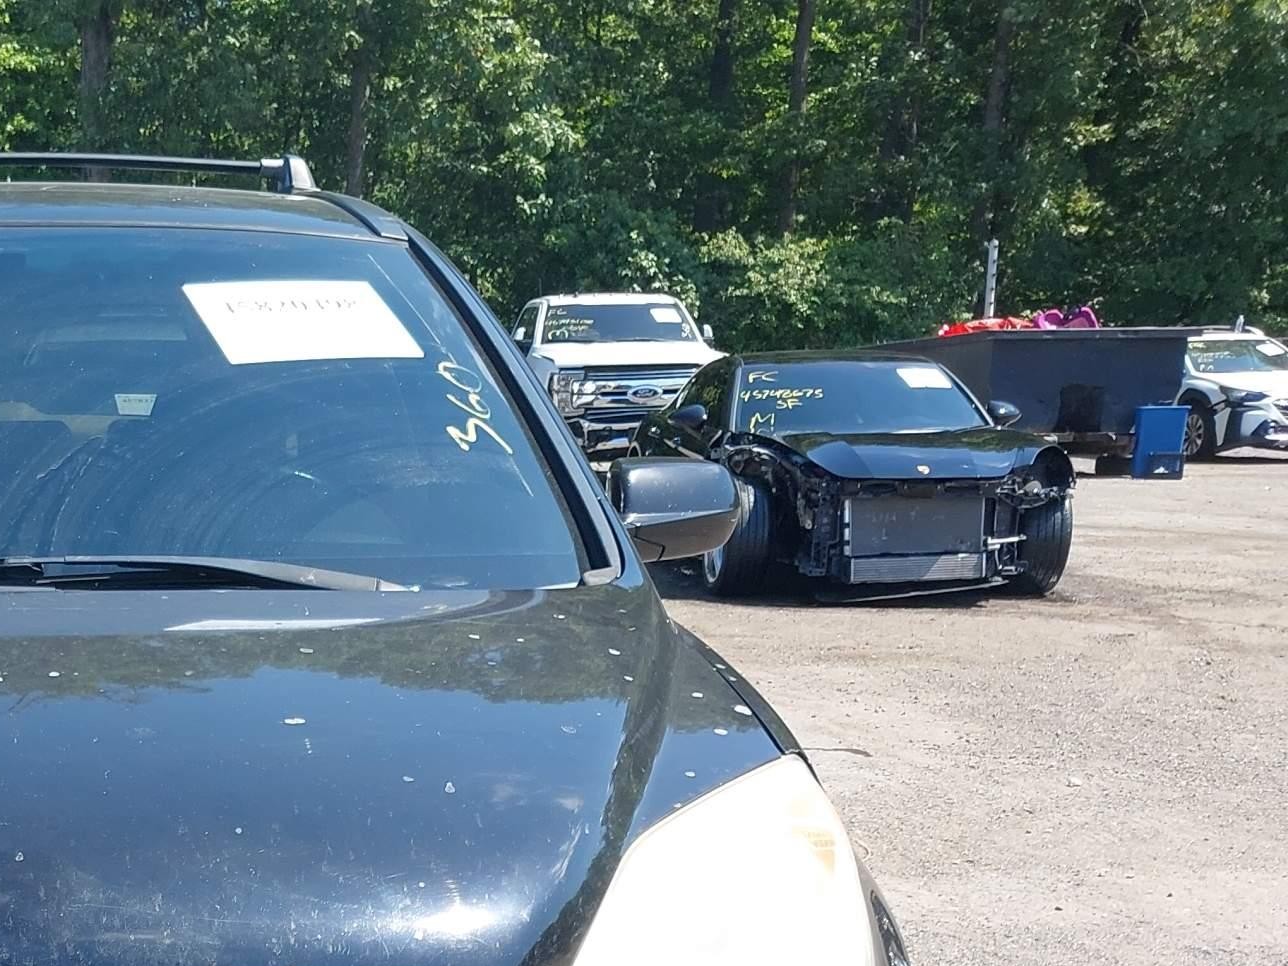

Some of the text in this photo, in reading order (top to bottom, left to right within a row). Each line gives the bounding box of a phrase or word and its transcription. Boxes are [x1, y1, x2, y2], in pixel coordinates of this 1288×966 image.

[748, 370, 779, 384] FC
[437, 360, 513, 455] 360
[775, 398, 804, 410] SF
